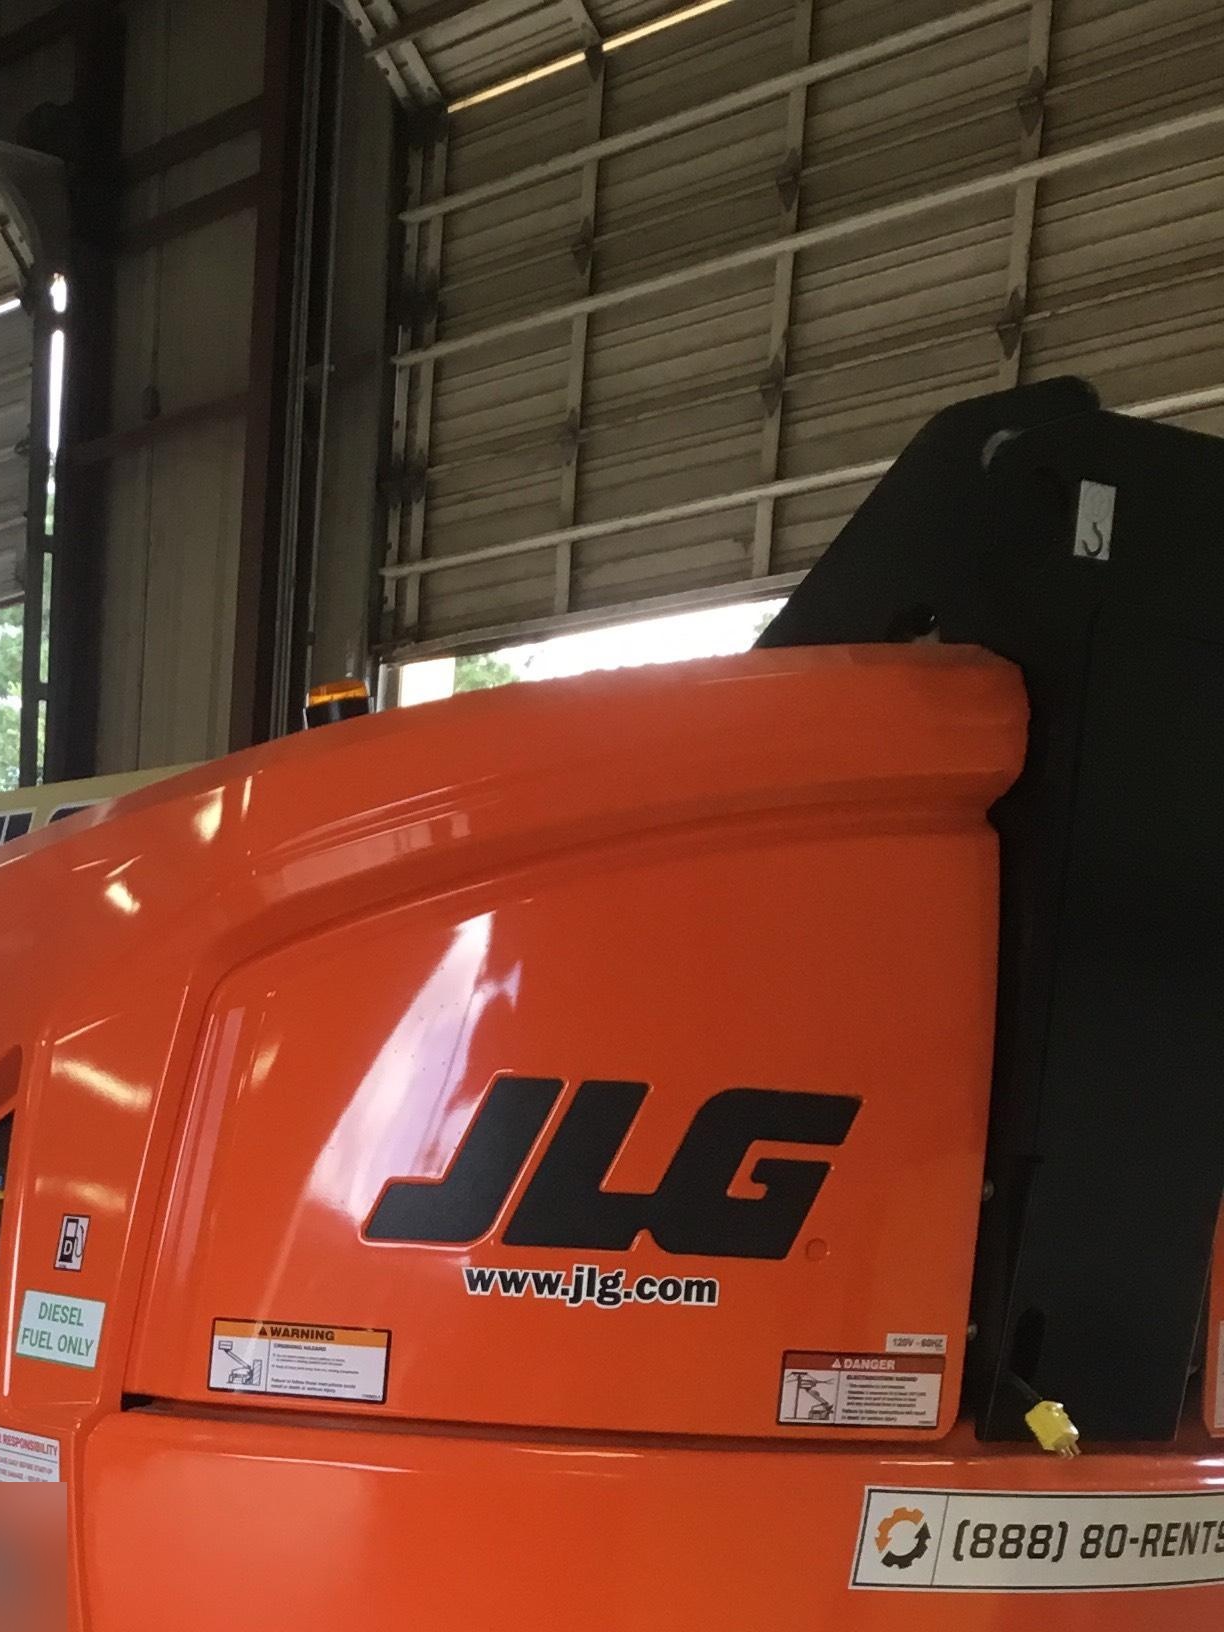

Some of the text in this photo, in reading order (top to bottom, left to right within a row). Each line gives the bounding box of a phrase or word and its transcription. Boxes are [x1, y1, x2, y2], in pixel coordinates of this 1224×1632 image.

[361, 1076, 863, 1260] JLG
[464, 1264, 718, 1307] www.jlg.com
[38, 1301, 84, 1327] DIESEL
[21, 1327, 94, 1357] FUEL ONLY
[270, 1326, 335, 1341] WARNING
[844, 1359, 896, 1370] DANGER
[3, 1433, 58, 1457] RESPONSIBILITY
[952, 1520, 1069, 1563] (888)
